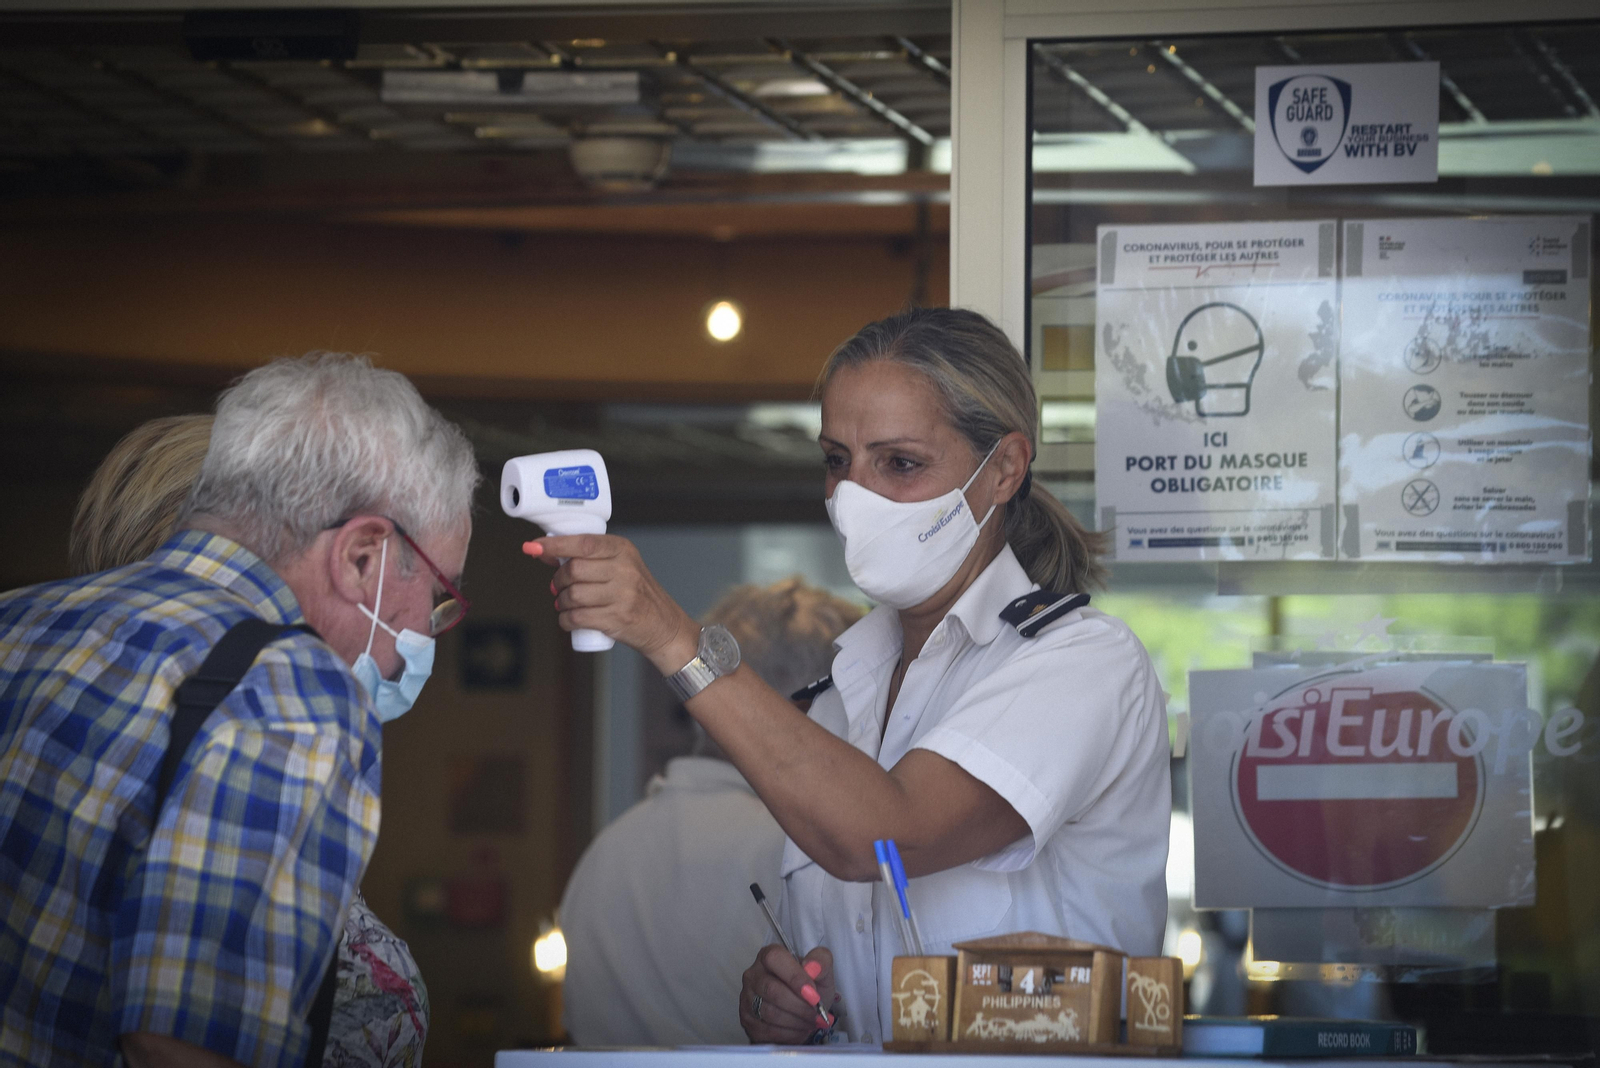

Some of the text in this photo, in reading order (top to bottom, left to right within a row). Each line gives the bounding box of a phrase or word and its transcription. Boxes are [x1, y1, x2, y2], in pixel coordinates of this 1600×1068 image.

[1292, 87, 1328, 105] SAFE
[1286, 104, 1334, 122] GUARD
[1351, 123, 1413, 135] RESTART
[1347, 132, 1430, 144] YOUR BUSINESS
[1344, 142, 1419, 158] WITH BV
[1122, 236, 1305, 254] CORONAVIRUS, POUR SE PROTÉGER
[1149, 249, 1280, 264] ET PROTÉGER LES AUTRES
[1461, 291, 1493, 301] POUR
[1203, 432, 1228, 448] ICI
[1125, 452, 1309, 472] PORT DU MASQUE
[1150, 474, 1284, 494] OBLIGATOIRE
[917, 500, 965, 543] CroisiEurope
[1127, 525, 1147, 535] Vous
[1172, 525, 1185, 535] des
[1374, 528, 1396, 538] Vous
[1397, 530, 1417, 538] avez
[1418, 528, 1434, 538] des
[972, 963, 1091, 995] SEPT 4 FRI
[982, 995, 1062, 1009] PHILIPPINES
[1317, 1032, 1371, 1048] RECORD BOOK
